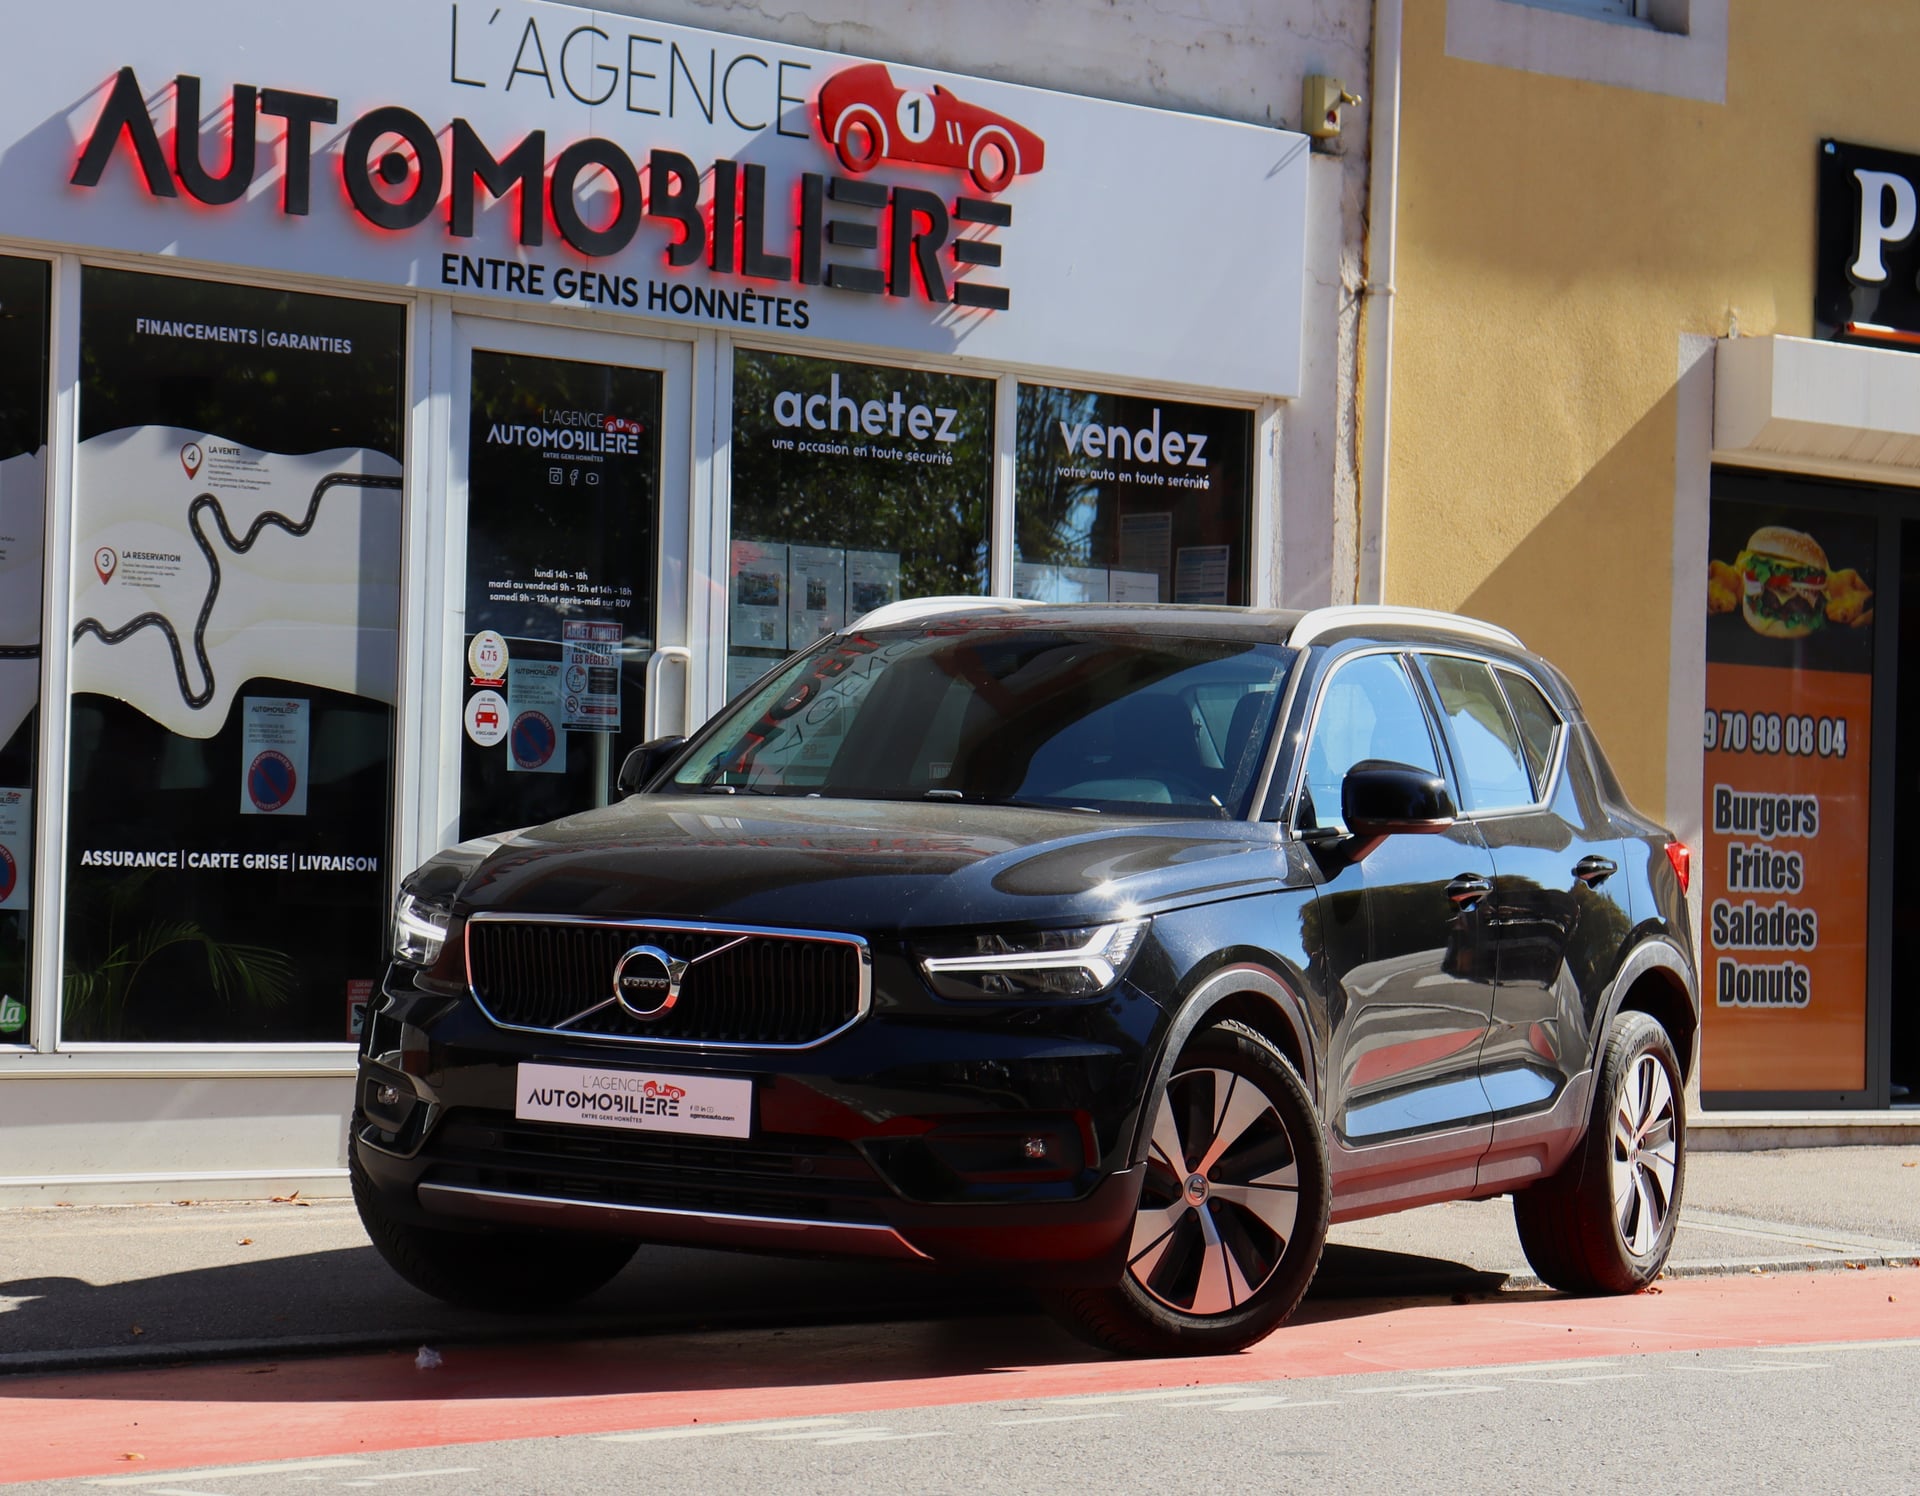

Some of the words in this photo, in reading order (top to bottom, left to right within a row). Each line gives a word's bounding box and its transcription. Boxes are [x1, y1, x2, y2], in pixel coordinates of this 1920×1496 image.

[450, 3, 812, 139] L'AGENCE
[907, 99, 921, 134] 1
[441, 252, 545, 297] ENTRE
[553, 267, 638, 308] GENS
[647, 281, 810, 329] HONNÊTES
[136, 318, 257, 345] FINANCEMENTS
[266, 331, 352, 355] GARANTIES
[542, 409, 604, 428] L'AGENCE
[773, 373, 958, 442] achetez
[486, 424, 639, 455] AUTOMOBILIERE
[1059, 408, 1208, 468] vendez
[187, 450, 196, 462] 4
[208, 446, 217, 454] LA
[218, 446, 241, 456] VENTE
[543, 452, 560, 460] ENTRE
[772, 438, 794, 449] une
[799, 440, 849, 456] occasion
[853, 446, 867, 457] en
[871, 445, 903, 461] toute
[1057, 466, 1086, 478] votre
[1090, 467, 1115, 481] auto
[1119, 472, 1132, 483] en
[1136, 471, 1164, 486] toute
[102, 553, 110, 568] 3
[122, 551, 131, 559] LA
[534, 569, 553, 578] lundi
[555, 570, 567, 579] 14h
[575, 571, 588, 580] 18h
[488, 580, 511, 589] mardi
[525, 582, 558, 591] vendredi
[560, 582, 569, 592] 9h
[577, 584, 589, 593] 12h
[590, 585, 598, 593] et
[600, 586, 612, 594] 14h
[620, 587, 632, 596] 18h
[490, 593, 518, 602] samedi
[519, 594, 529, 602] 9h
[537, 594, 549, 603] 12h
[551, 595, 558, 603] et
[615, 599, 631, 608] RDV
[571, 654, 583, 664] LES
[1720, 710, 1748, 752] 70
[1751, 712, 1782, 754] 98
[1785, 715, 1815, 755] 08
[1818, 717, 1846, 757] 04
[1714, 787, 1817, 837] Burgers
[80, 850, 178, 869] ASSURANCE
[187, 852, 239, 870] CARTE
[242, 853, 289, 870] GRISE
[299, 855, 378, 872] LIVRAISON
[1729, 846, 1802, 890] Frites
[1712, 903, 1815, 947] Salades
[623, 977, 667, 988] VOLVO
[1718, 961, 1808, 1004] Donuts
[582, 1075, 643, 1092] L'AGENCE
[527, 1088, 680, 1117] AUTOMOBILIERE
